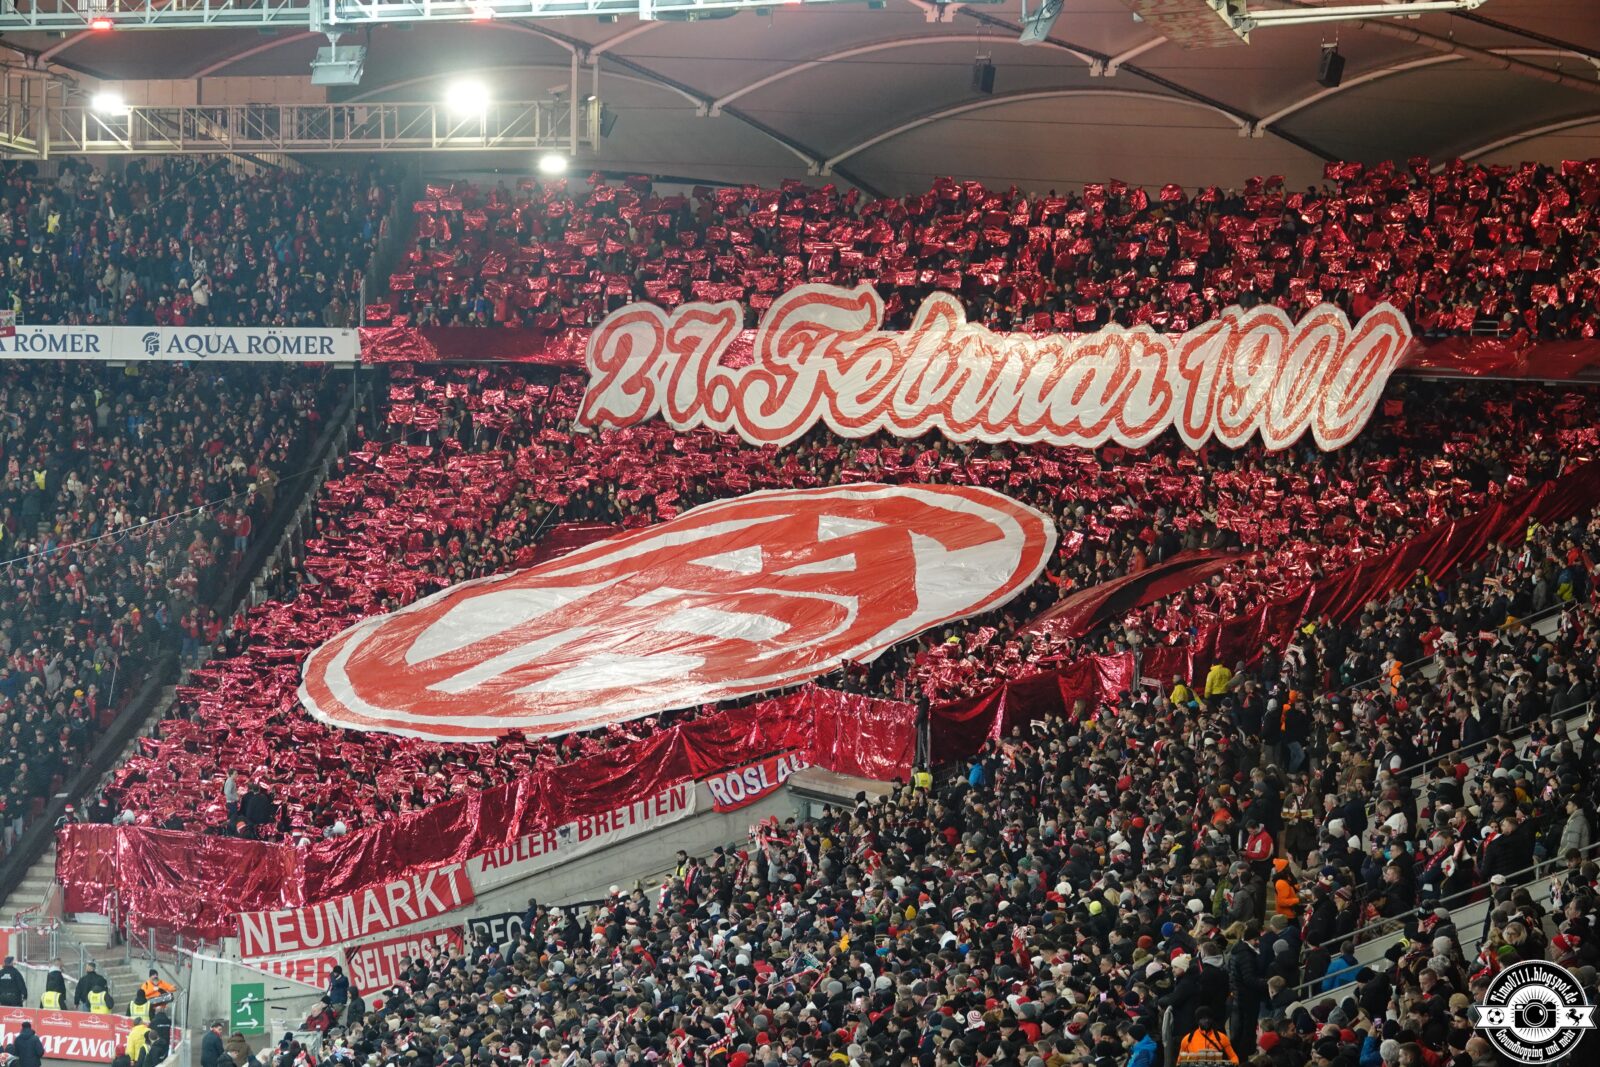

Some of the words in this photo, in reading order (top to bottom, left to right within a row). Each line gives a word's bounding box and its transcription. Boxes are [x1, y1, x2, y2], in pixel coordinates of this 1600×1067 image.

[14, 328, 100, 353] RÖMER
[166, 334, 240, 358] AQUA
[246, 330, 336, 355] RÖMER
[736, 290, 1174, 441] Februar
[1177, 309, 1409, 442] 1900
[481, 830, 558, 873] ADLER
[577, 785, 687, 842] BRETTEN
[241, 862, 463, 956] NEUMARKT
